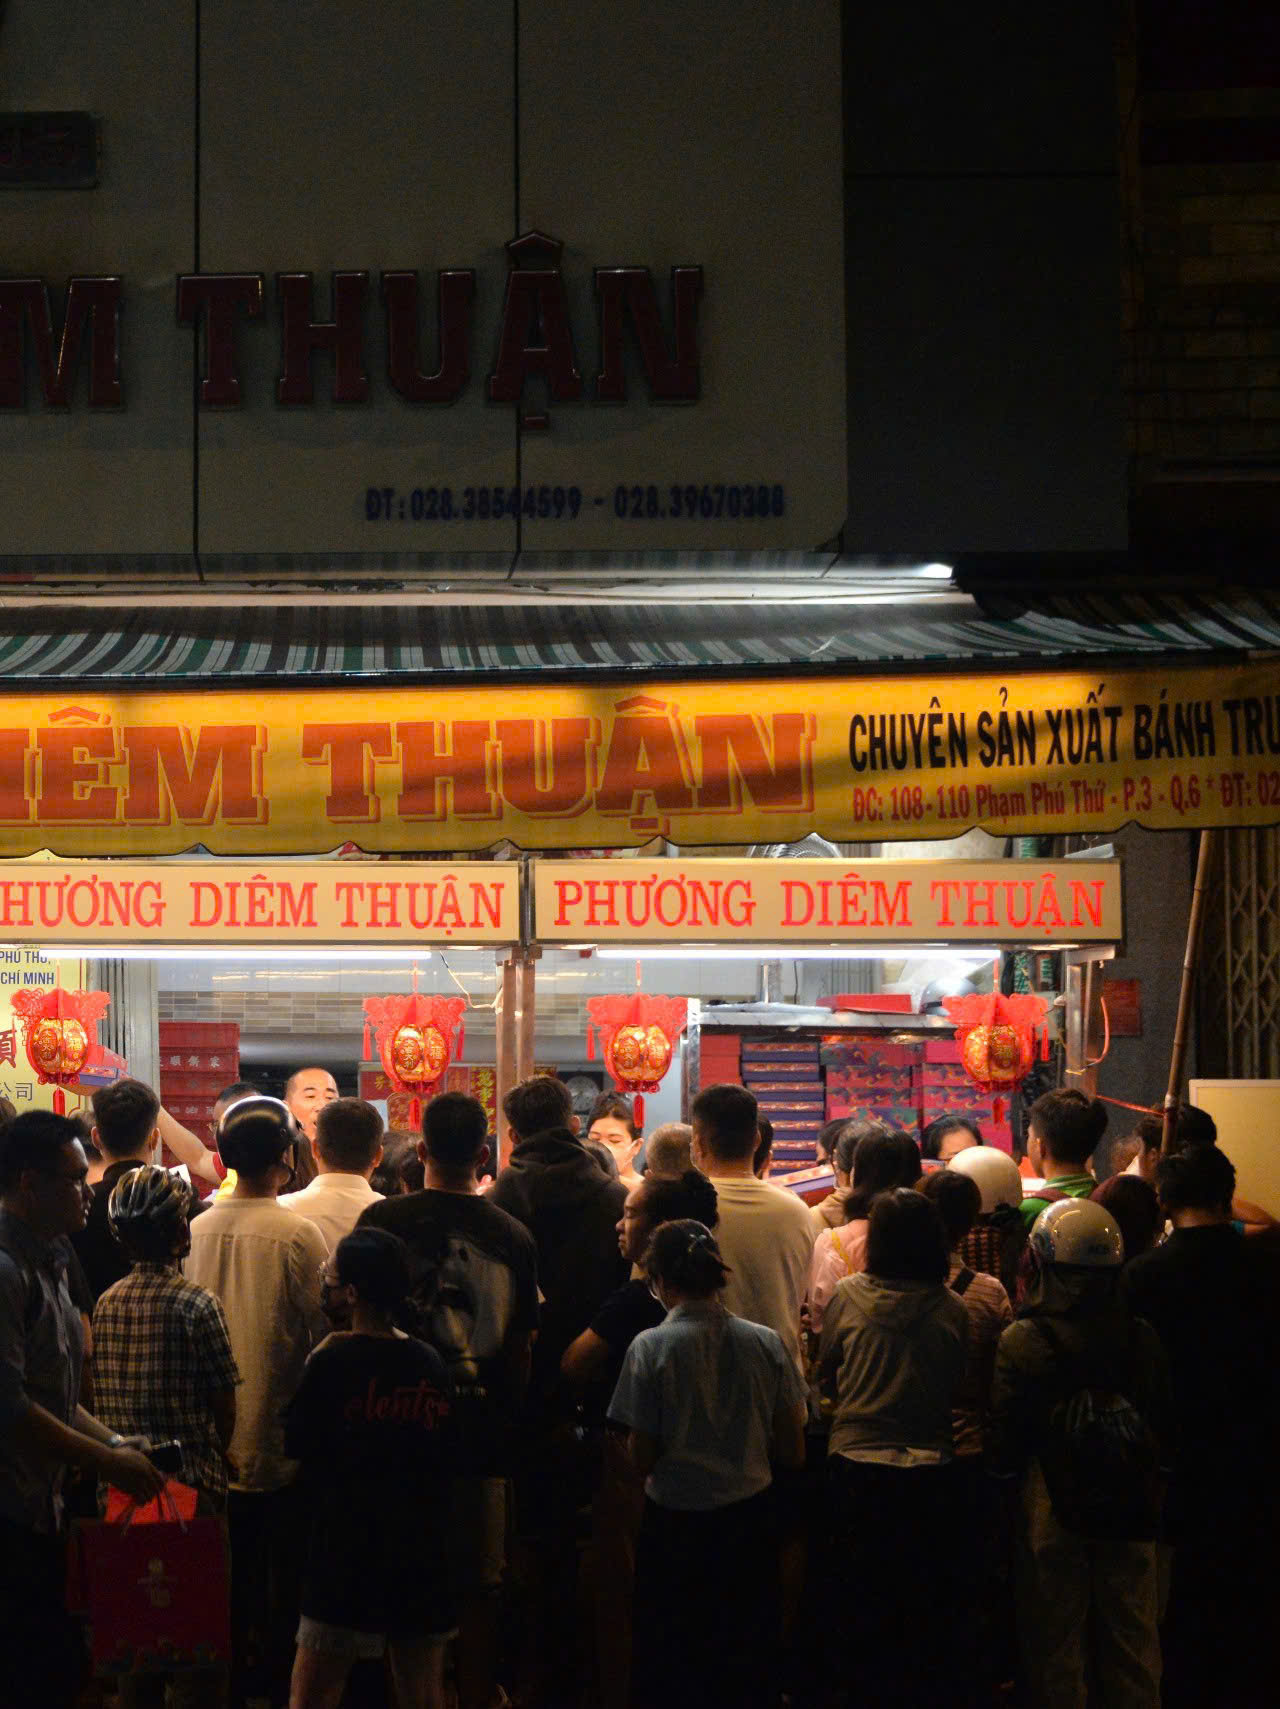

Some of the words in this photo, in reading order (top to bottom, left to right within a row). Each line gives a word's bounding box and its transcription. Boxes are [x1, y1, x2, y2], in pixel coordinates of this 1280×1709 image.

[177, 228, 705, 431] THUẬN
[849, 696, 968, 772] CHUYÊN
[976, 686, 1036, 768] SẢN
[1045, 684, 1123, 766] XUẤT
[1133, 688, 1216, 760] BÁNH
[302, 695, 818, 837] THUẬN
[852, 786, 883, 822] ĐC:
[975, 783, 1026, 824] Phạm
[1030, 781, 1065, 816] Phú
[1070, 778, 1106, 815] Thứ
[1123, 775, 1152, 812] P.3
[1170, 773, 1201, 816] Q.6
[1221, 772, 1253, 808] ĐT:
[189, 873, 318, 928] DIÊM
[335, 873, 506, 936] THUẬN
[553, 873, 756, 928] PHƯƠNG
[780, 872, 913, 927] DIÊM
[930, 872, 1106, 935] THUẬN
[1, 969, 20, 985] CHÍ
[23, 971, 55, 985] MINH
